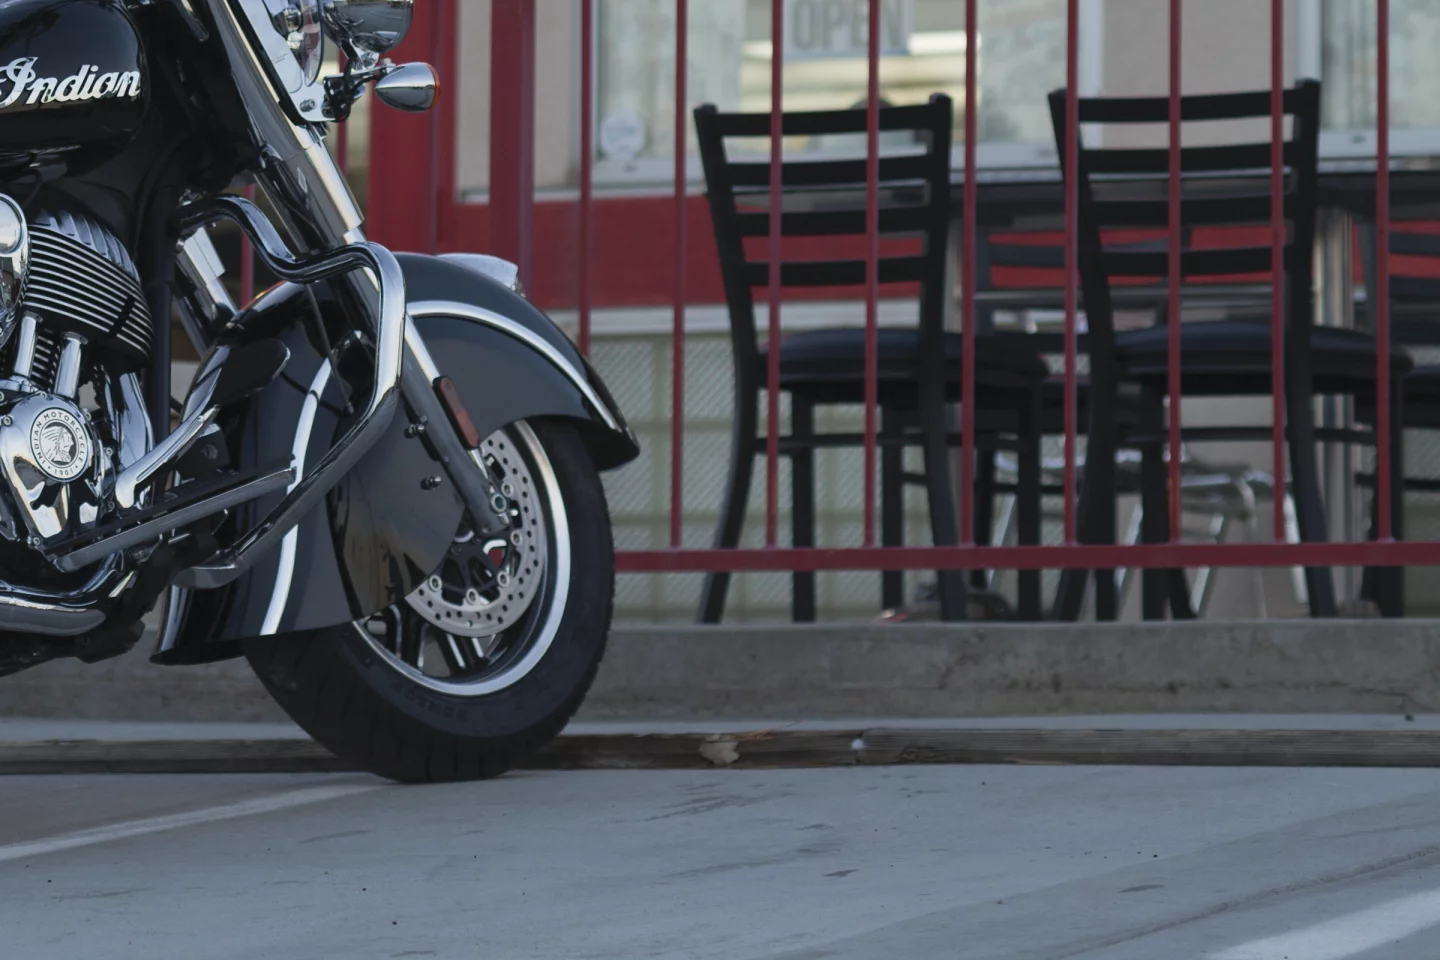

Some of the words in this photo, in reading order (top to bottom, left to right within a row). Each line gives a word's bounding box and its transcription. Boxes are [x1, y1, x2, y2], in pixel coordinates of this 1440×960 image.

[34, 421, 46, 464] INDIAN
[43, 412, 85, 463] MOTORCYCLE
[54, 468, 74, 476] 1901
